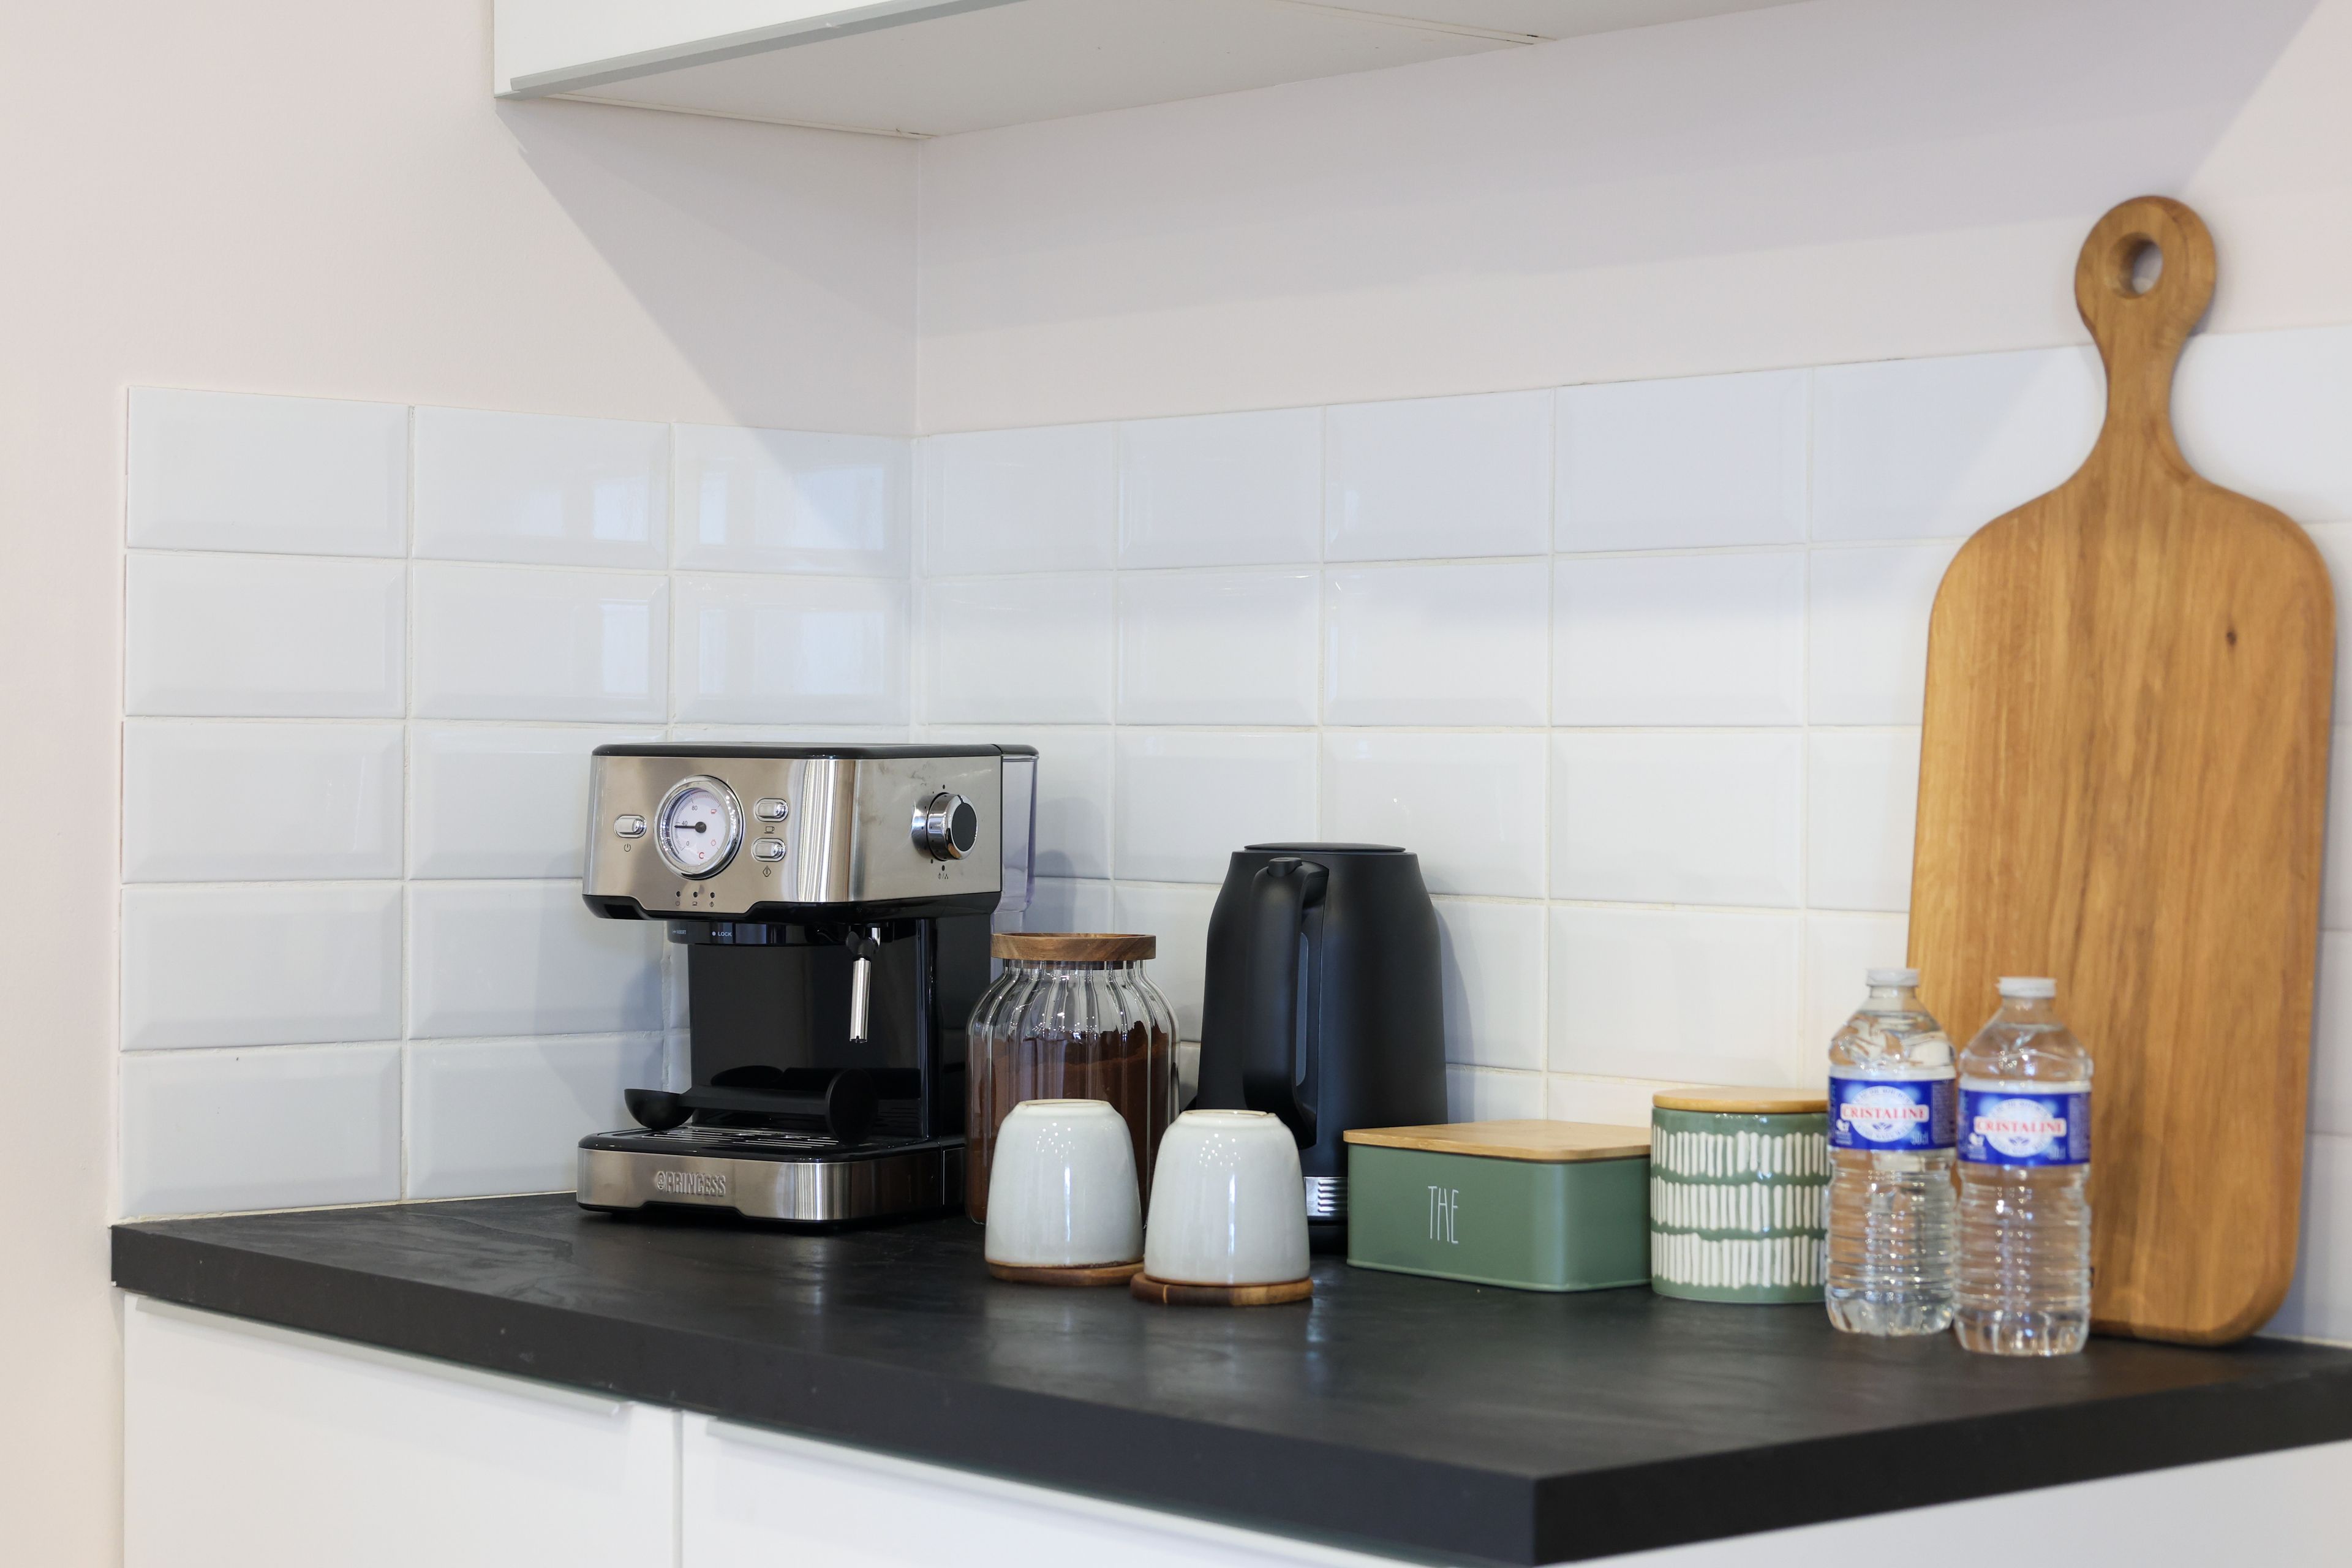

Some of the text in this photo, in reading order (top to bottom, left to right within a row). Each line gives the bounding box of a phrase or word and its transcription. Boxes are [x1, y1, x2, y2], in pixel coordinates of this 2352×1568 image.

[1842, 1106, 1924, 1120] CRISTALINE
[1976, 1121, 2062, 1134] CRISTALINE
[665, 1171, 726, 1197] PRINCESS
[1428, 1186, 1459, 1244] THE
